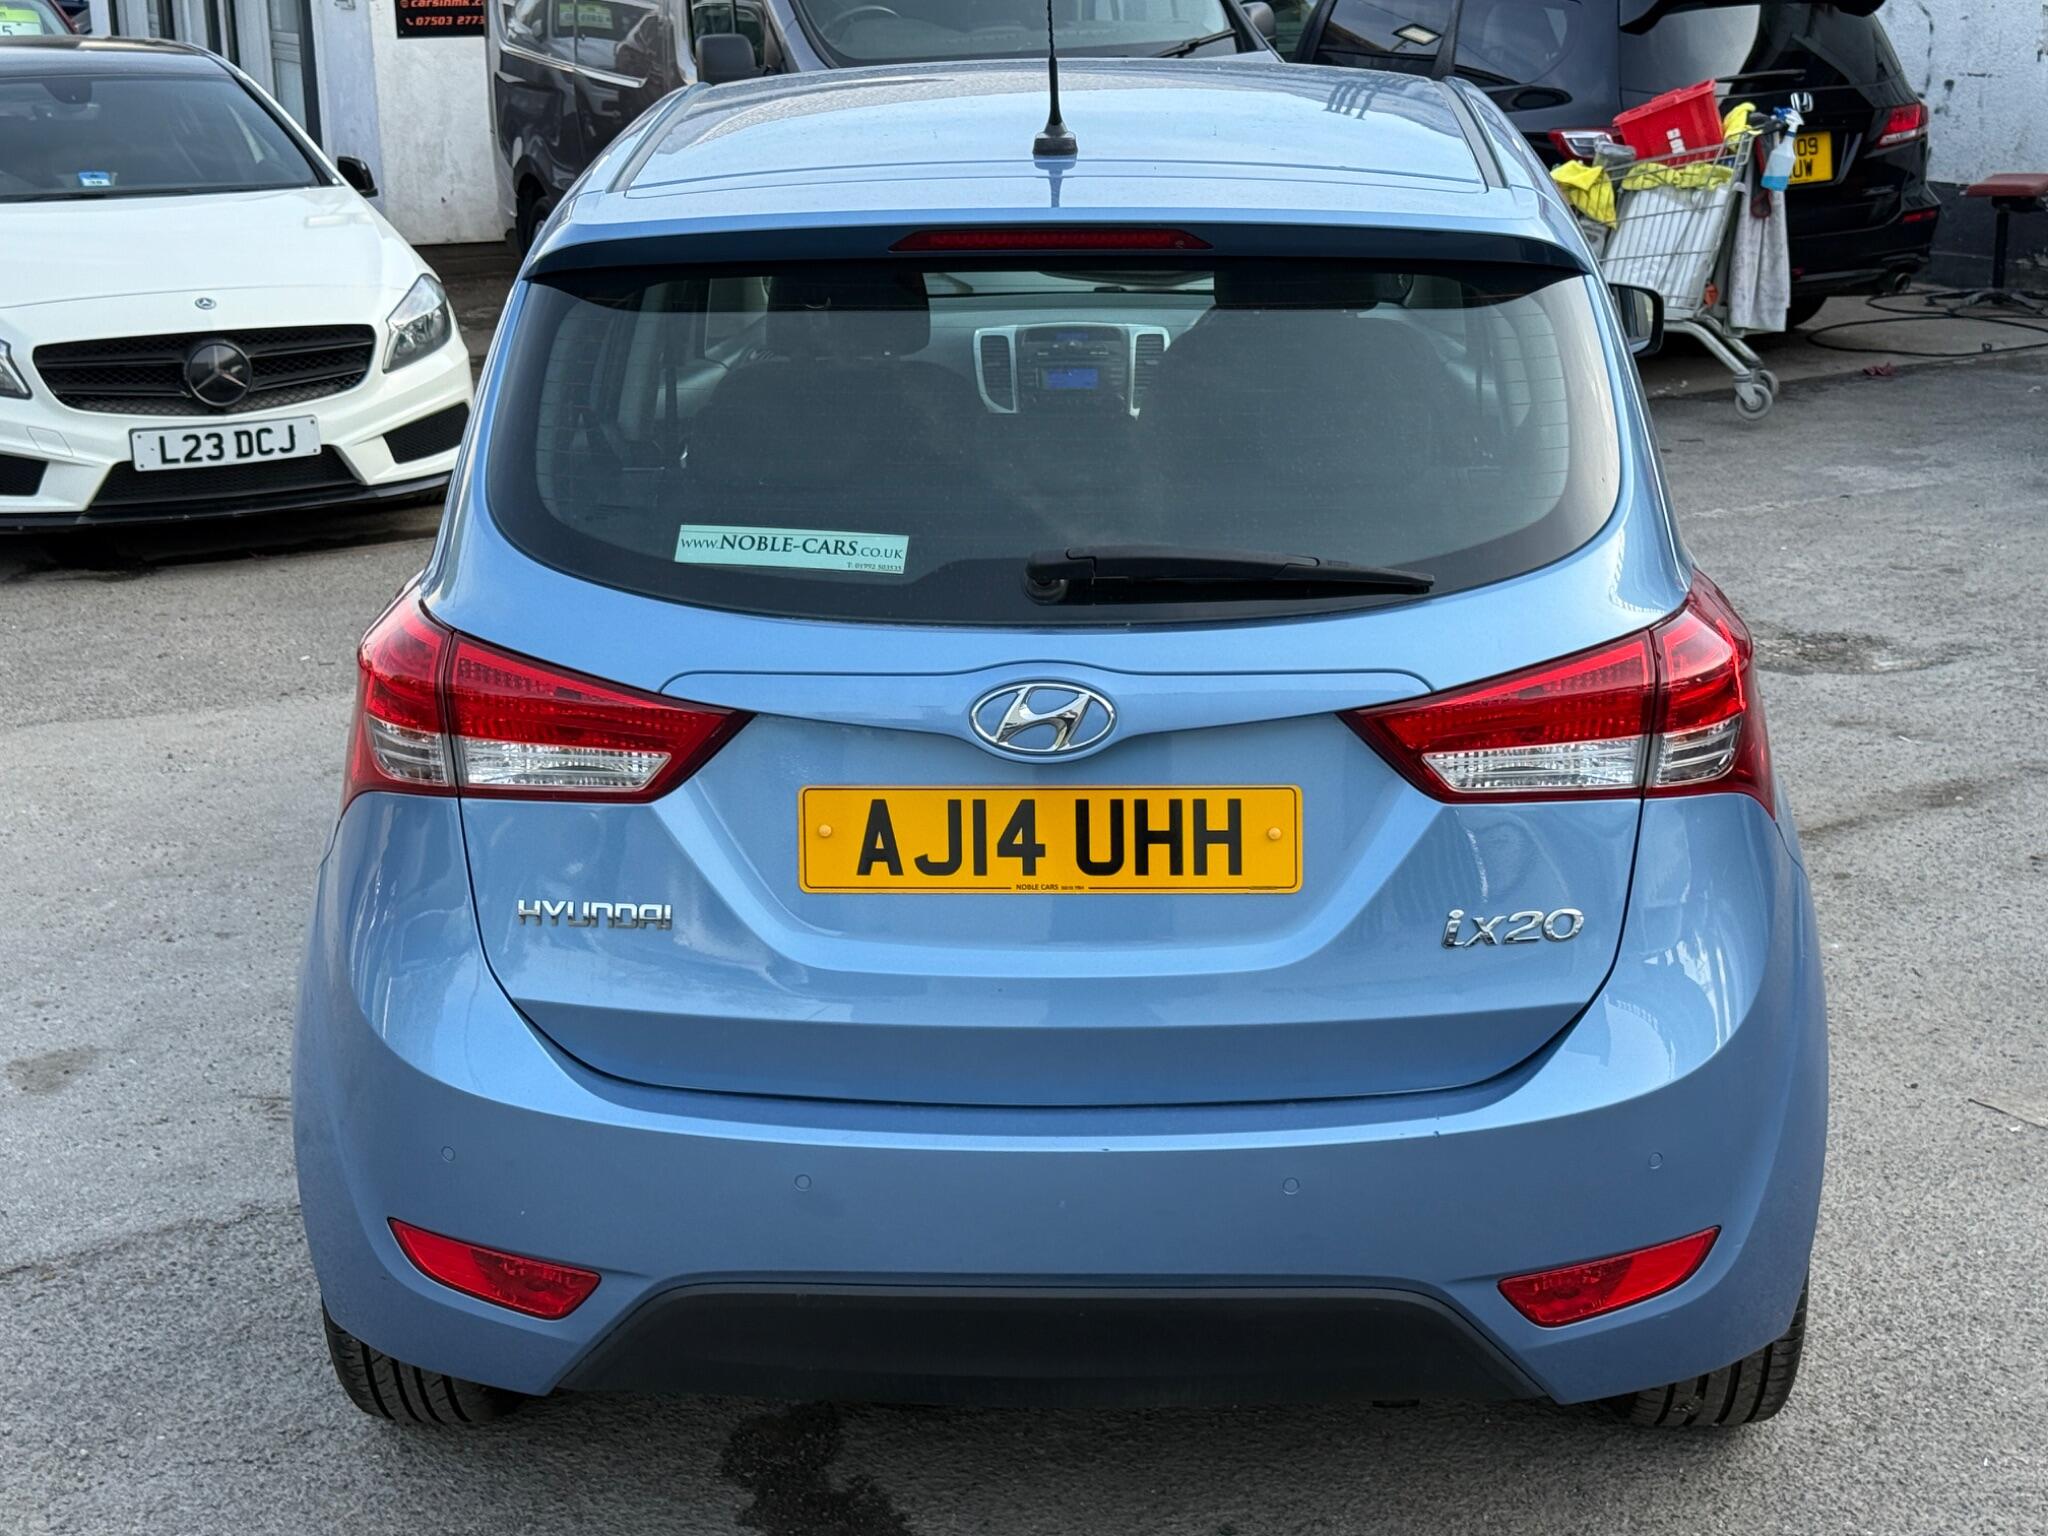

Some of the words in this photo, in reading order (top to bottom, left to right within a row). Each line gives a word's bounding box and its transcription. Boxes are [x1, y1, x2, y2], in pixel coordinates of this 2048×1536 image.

[416, 16, 453, 26] 07503
[158, 432, 225, 465] L23
[233, 424, 296, 459] DCJ
[856, 798, 1046, 876] AJ14
[1075, 798, 1243, 876] UHH
[1016, 883, 1039, 891] NOBLE
[1040, 883, 1059, 891] CARS
[517, 899, 673, 930] HYUNDAI
[1442, 908, 1585, 949] ix20
